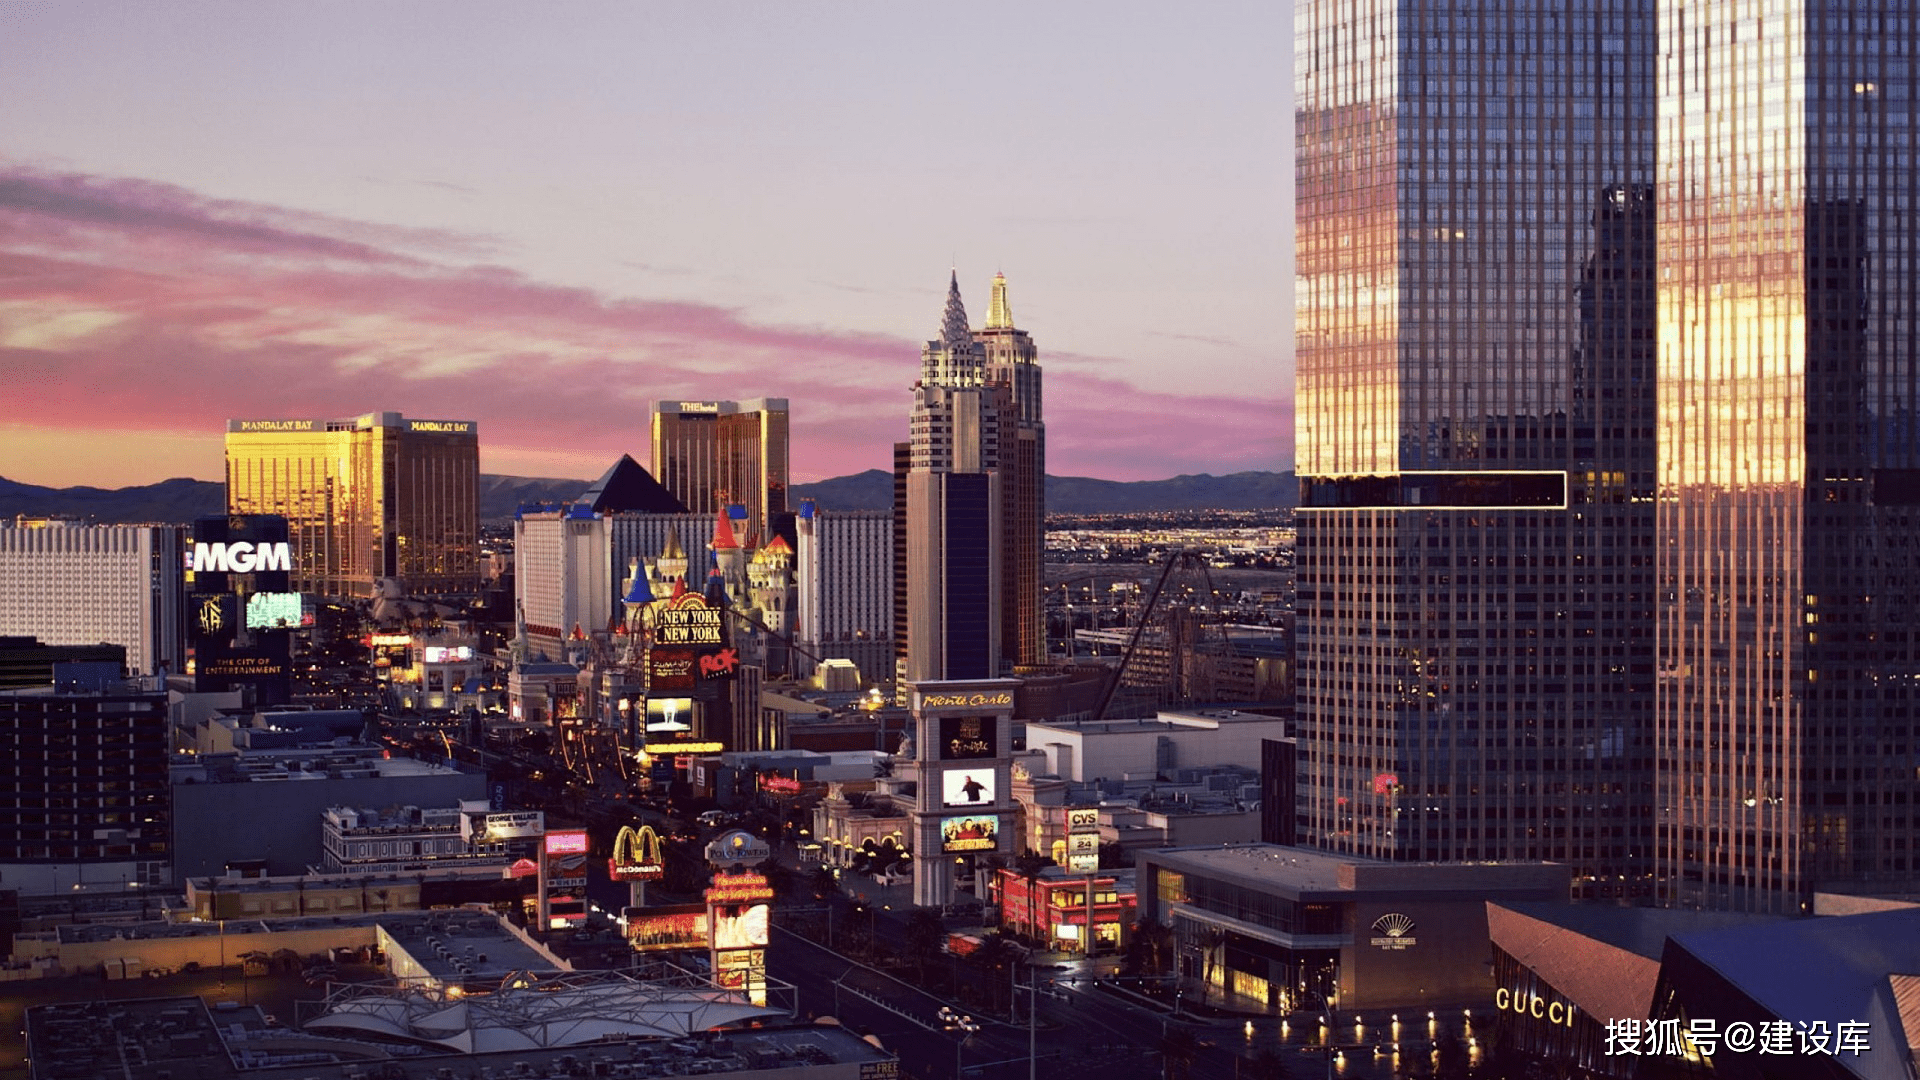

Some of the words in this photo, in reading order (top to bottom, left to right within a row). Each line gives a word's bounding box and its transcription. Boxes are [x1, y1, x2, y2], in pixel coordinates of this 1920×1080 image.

[241, 421, 293, 431] MANDALAY
[295, 421, 313, 430] BAY
[411, 421, 454, 431] MANDALAY
[193, 541, 292, 573] MGM
[663, 610, 689, 624] NEW
[691, 610, 721, 624] YORK
[663, 627, 689, 641] NEW
[691, 627, 721, 641] YORK
[217, 658, 234, 666] THE
[205, 666, 282, 675] ENTERTAINMENT
[922, 694, 967, 707] Monte
[969, 692, 1011, 706] Carlo
[1072, 813, 1096, 824] CVS
[616, 865, 662, 874] McDonald's
[1496, 987, 1574, 1027] GUCCI
[877, 1062, 898, 1072] FREE
